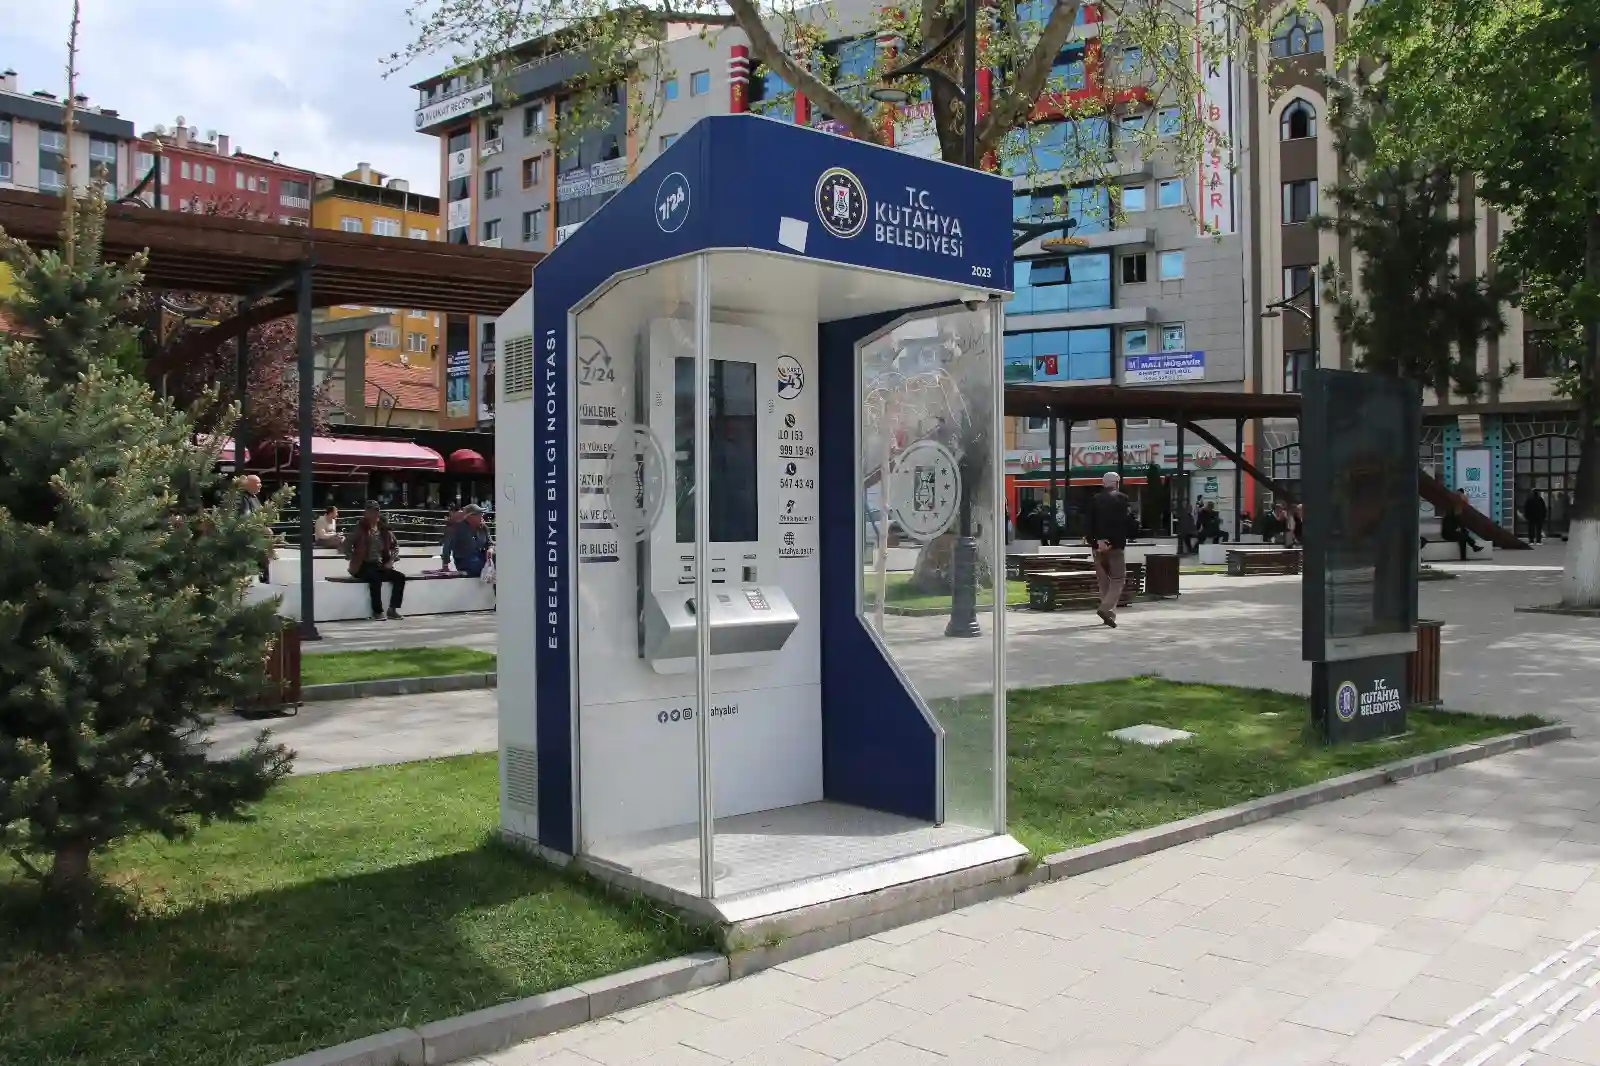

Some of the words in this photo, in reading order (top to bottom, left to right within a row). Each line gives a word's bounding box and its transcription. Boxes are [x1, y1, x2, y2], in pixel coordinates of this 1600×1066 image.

[658, 185, 685, 220] 7/24
[905, 186, 934, 210] T.C.
[875, 201, 963, 237] KÜTAHYA
[875, 223, 963, 258] BELEDİYESİ
[971, 265, 992, 278] 2023
[546, 329, 556, 431] NOKTASI
[583, 366, 615, 382] 7/24
[579, 404, 617, 418] ÜKLEME
[545, 439, 557, 500] BİLGİ
[546, 509, 558, 649] E-BELEDİYE
[1361, 688, 1400, 705] KÜTAHYA
